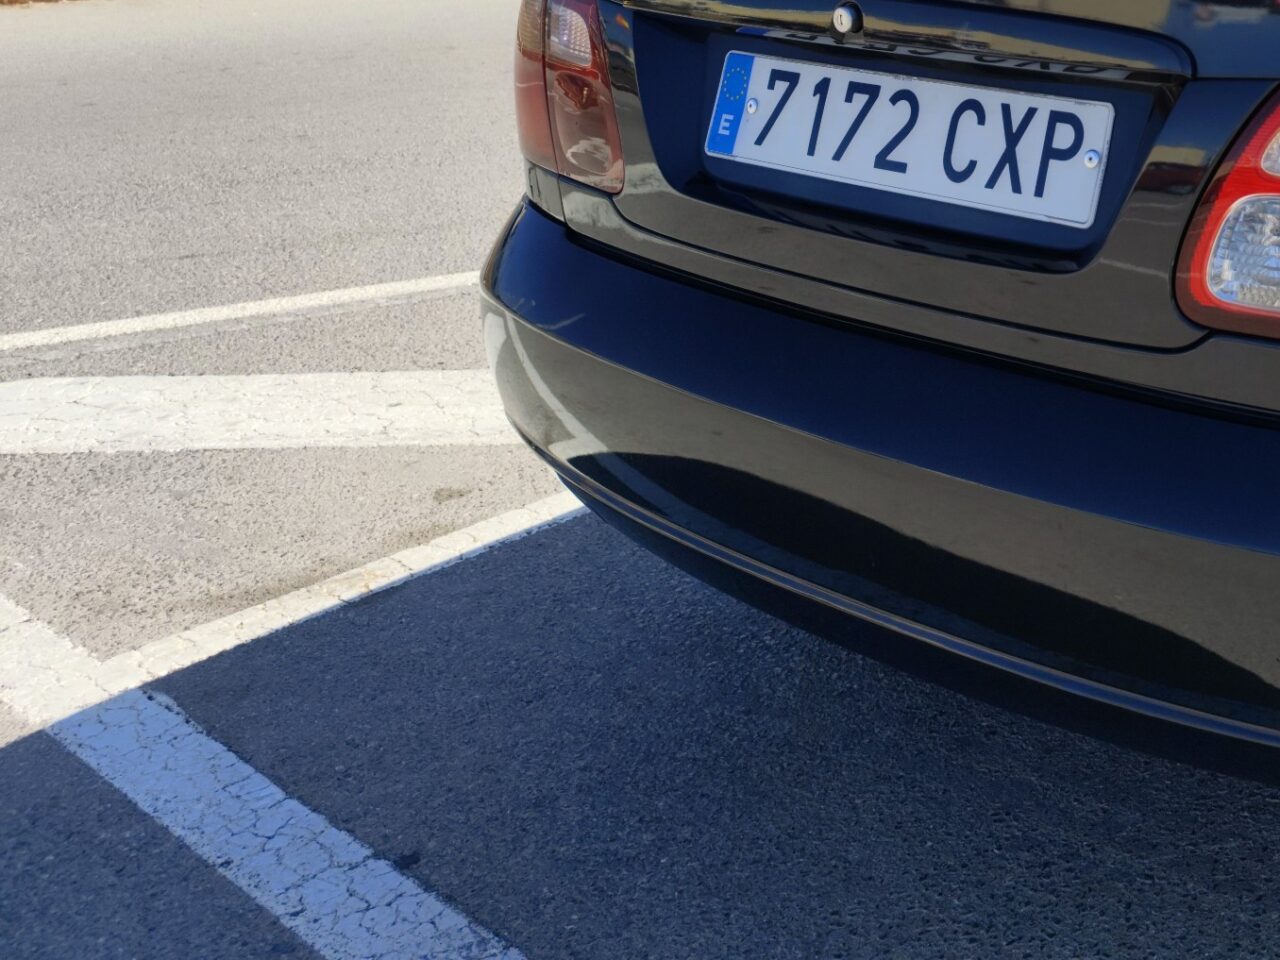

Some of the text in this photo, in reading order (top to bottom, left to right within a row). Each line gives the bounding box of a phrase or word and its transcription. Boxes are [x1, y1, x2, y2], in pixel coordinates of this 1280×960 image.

[717, 68, 1086, 199] E 7172 CXP
